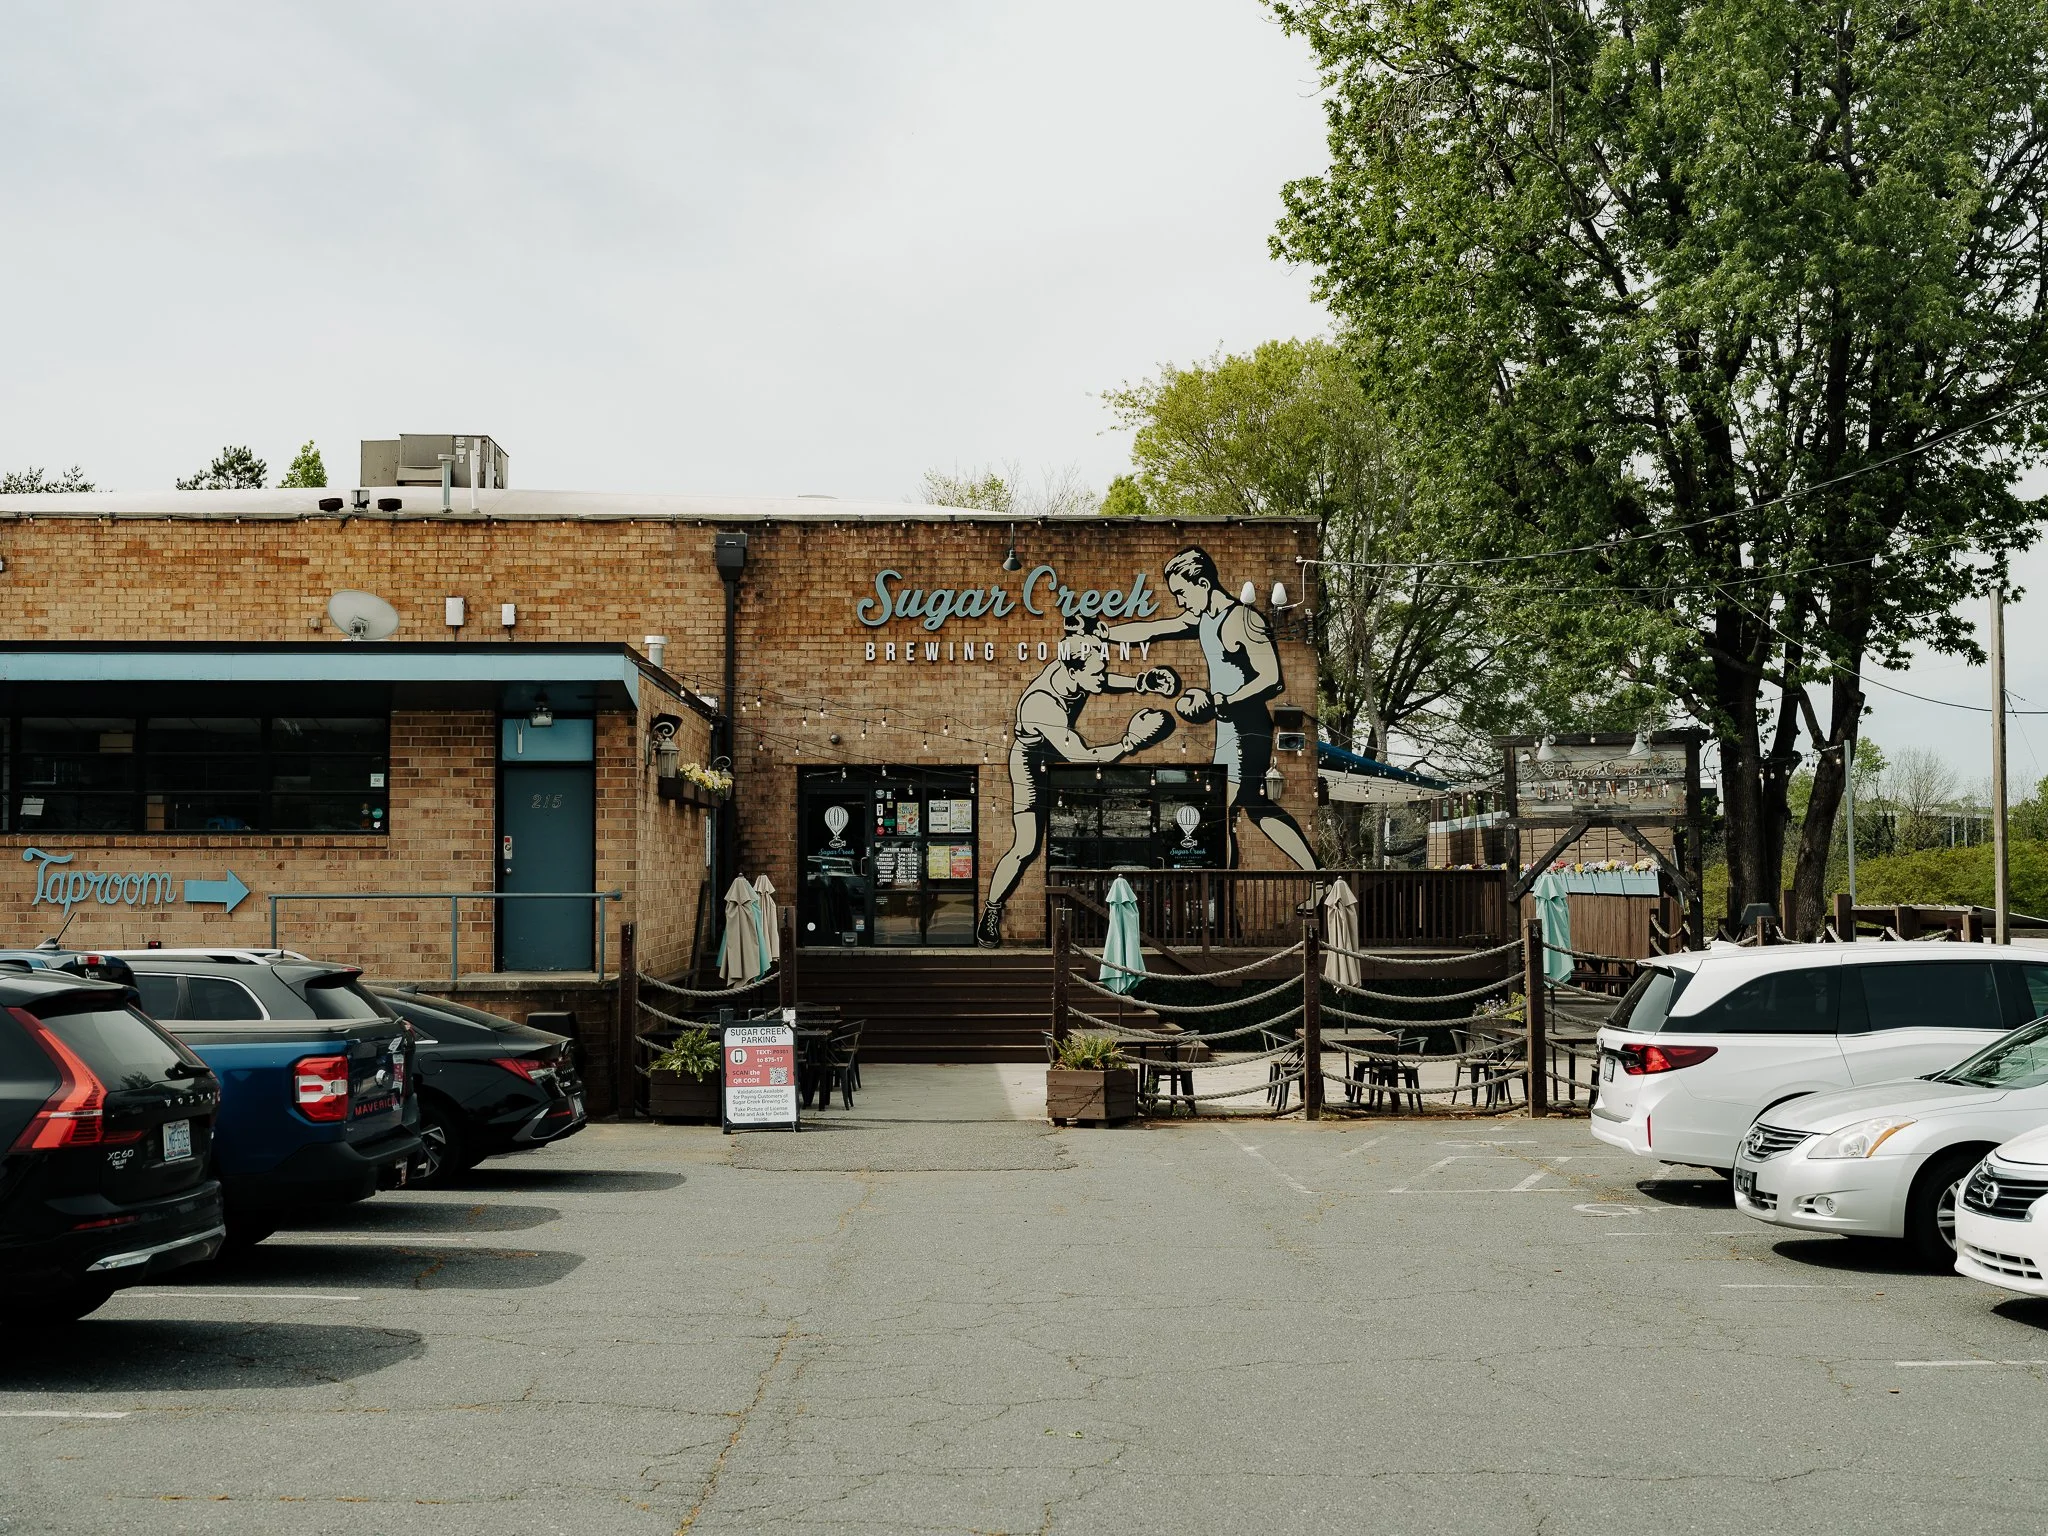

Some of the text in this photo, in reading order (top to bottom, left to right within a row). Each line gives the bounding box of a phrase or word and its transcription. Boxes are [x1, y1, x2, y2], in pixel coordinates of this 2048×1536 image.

[856, 565, 1160, 631] Sugar Creek
[865, 641, 1151, 661] BREWING COMPANY
[1558, 761, 1641, 779] Sugar Creek
[1537, 779, 1671, 800] GARDEN BAR
[531, 793, 563, 809] 215
[818, 848, 837, 856] Sugar
[1170, 847, 1206, 856] Sugar Creek
[22, 847, 177, 918] Taproom
[730, 1027, 787, 1036] SUGAR CREEK
[741, 1036, 777, 1044] PARKING
[164, 1092, 212, 1108] VOLVO
[107, 1149, 134, 1161] XC60
